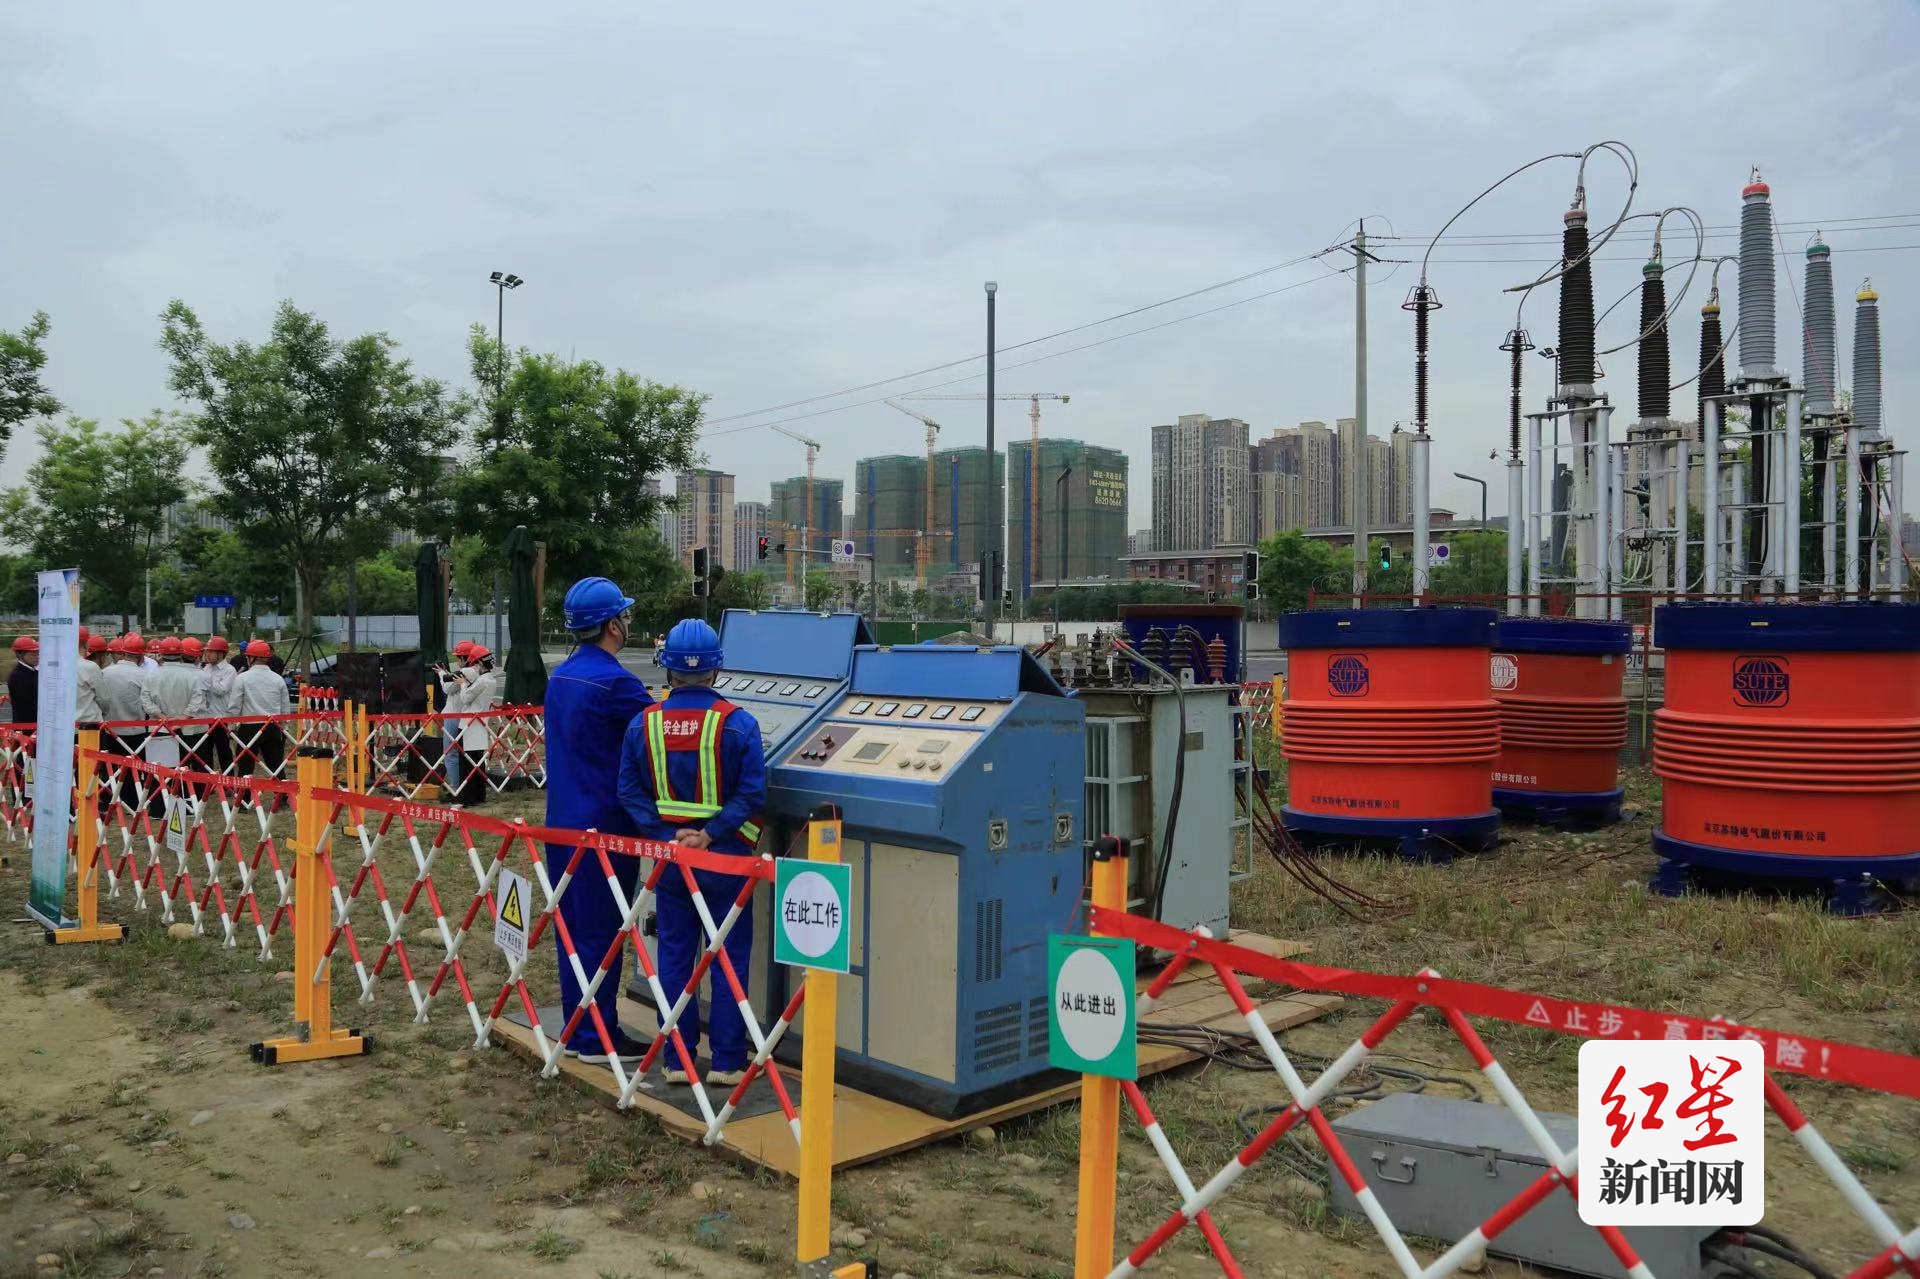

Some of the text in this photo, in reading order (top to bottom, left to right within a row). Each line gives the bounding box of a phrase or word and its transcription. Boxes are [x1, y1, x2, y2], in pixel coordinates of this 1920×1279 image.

[1329, 669, 1367, 682] SUTE
[1491, 666, 1517, 677] UTE
[1735, 673, 1786, 689] SUTE
[663, 719, 699, 735] 安全监护
[785, 898, 839, 928] 在此工作
[1061, 991, 1116, 1016] 从此进出
